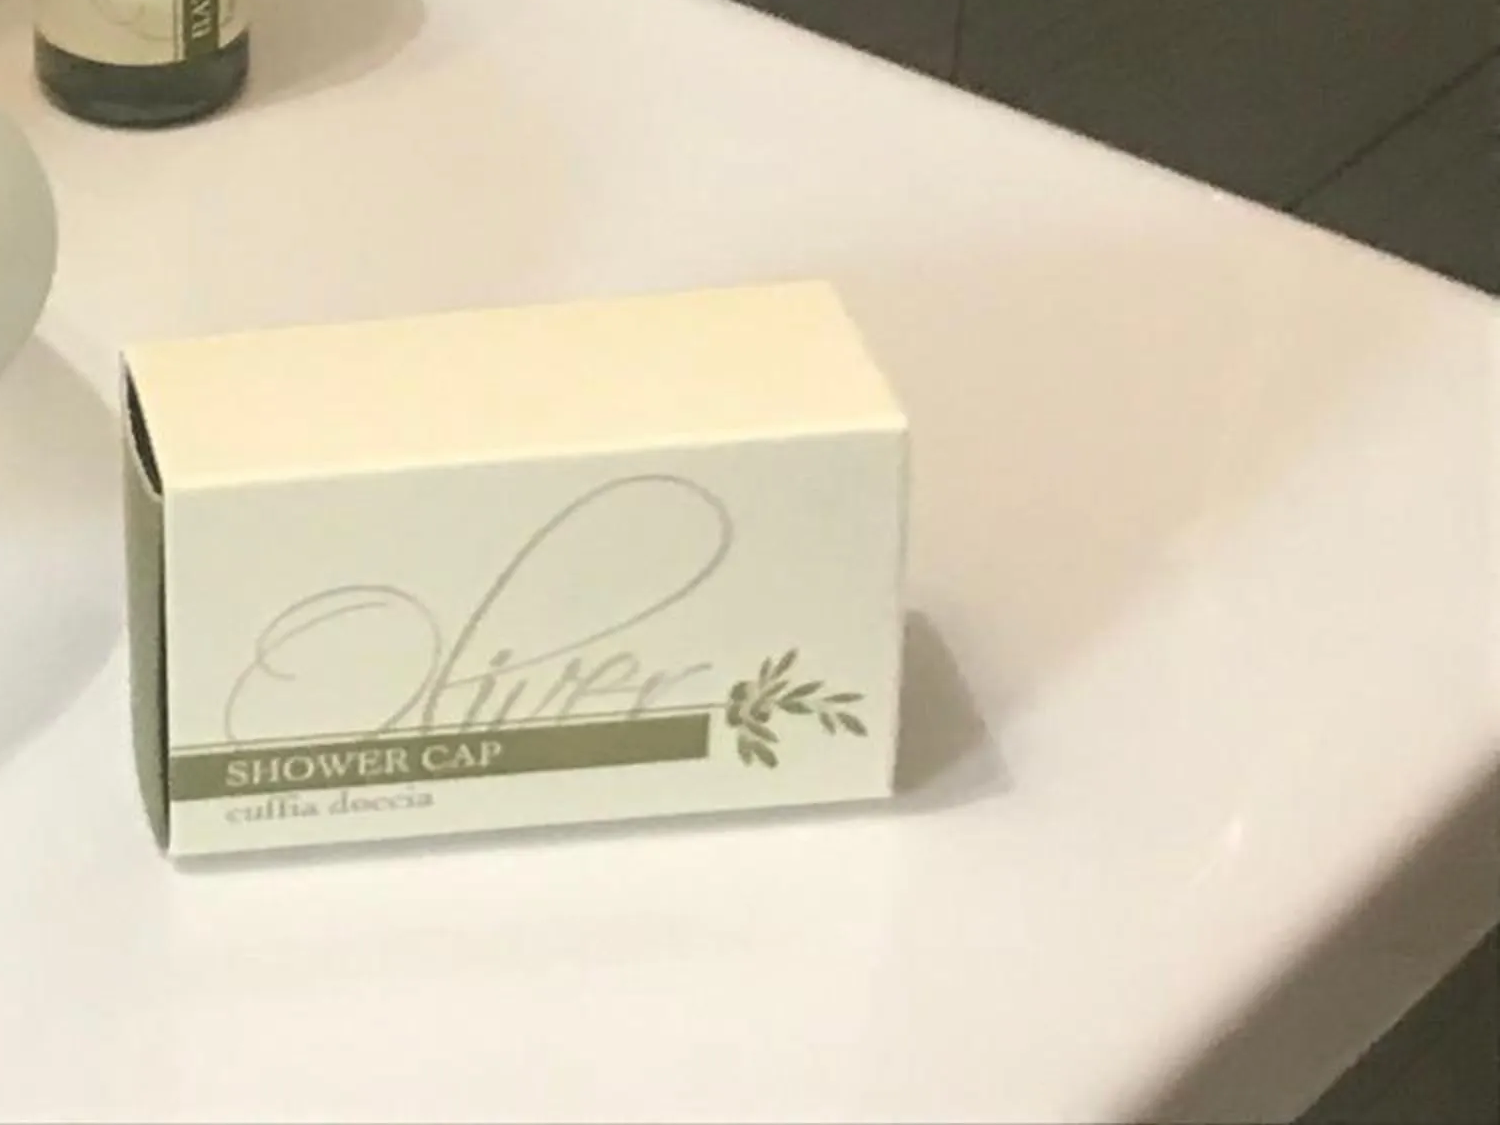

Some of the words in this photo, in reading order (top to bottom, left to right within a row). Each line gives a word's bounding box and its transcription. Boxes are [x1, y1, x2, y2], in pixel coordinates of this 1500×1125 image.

[225, 746, 411, 788] SHOWER
[420, 739, 504, 772] CAP
[224, 792, 320, 824] cuffia
[327, 785, 435, 816] doccia
